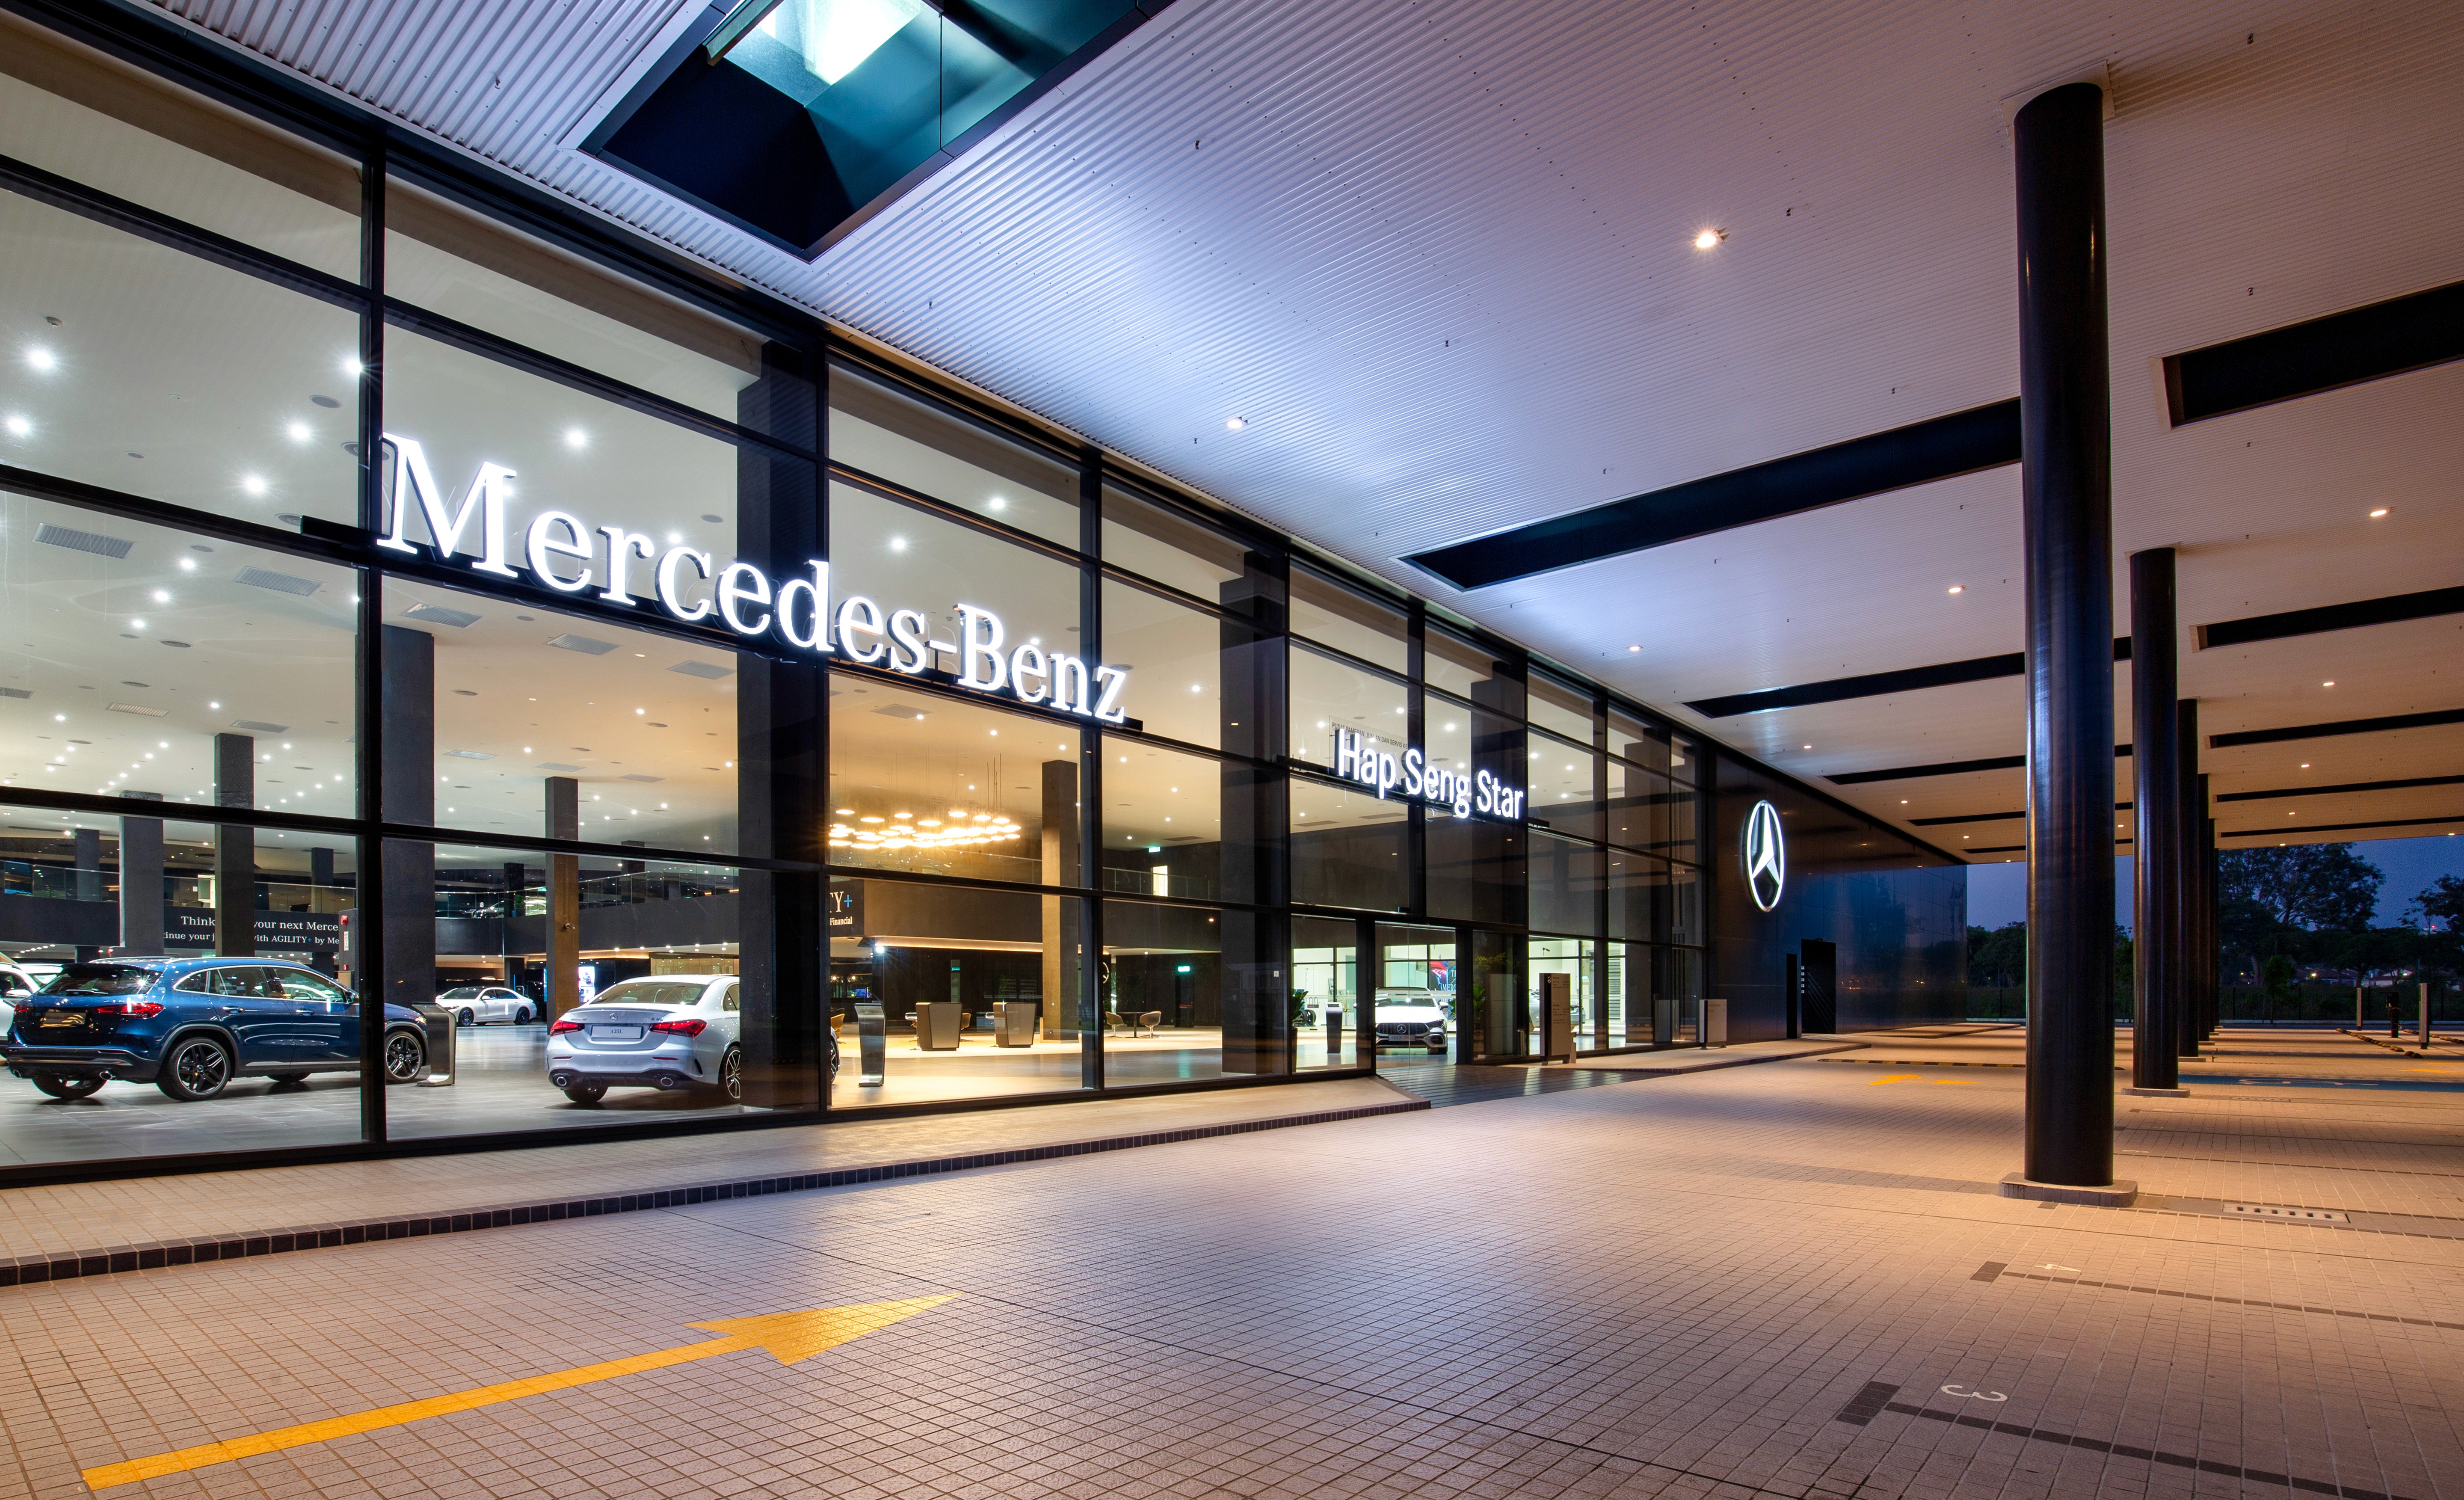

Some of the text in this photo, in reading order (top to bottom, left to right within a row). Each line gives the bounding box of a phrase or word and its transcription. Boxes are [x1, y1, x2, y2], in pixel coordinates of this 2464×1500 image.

[376, 432, 1126, 723] Mercedes-Benz
[1390, 739, 1403, 748] SERVIS
[1338, 728, 1523, 819] Hap Seng Star
[181, 916, 216, 926] Think
[306, 922, 338, 931] Merce
[830, 916, 853, 925] Financial
[271, 935, 312, 943] AGILITY+
[315, 937, 325, 945] by
[2035, 1263, 2082, 1272] 4
[1941, 1384, 2008, 1401] 3
